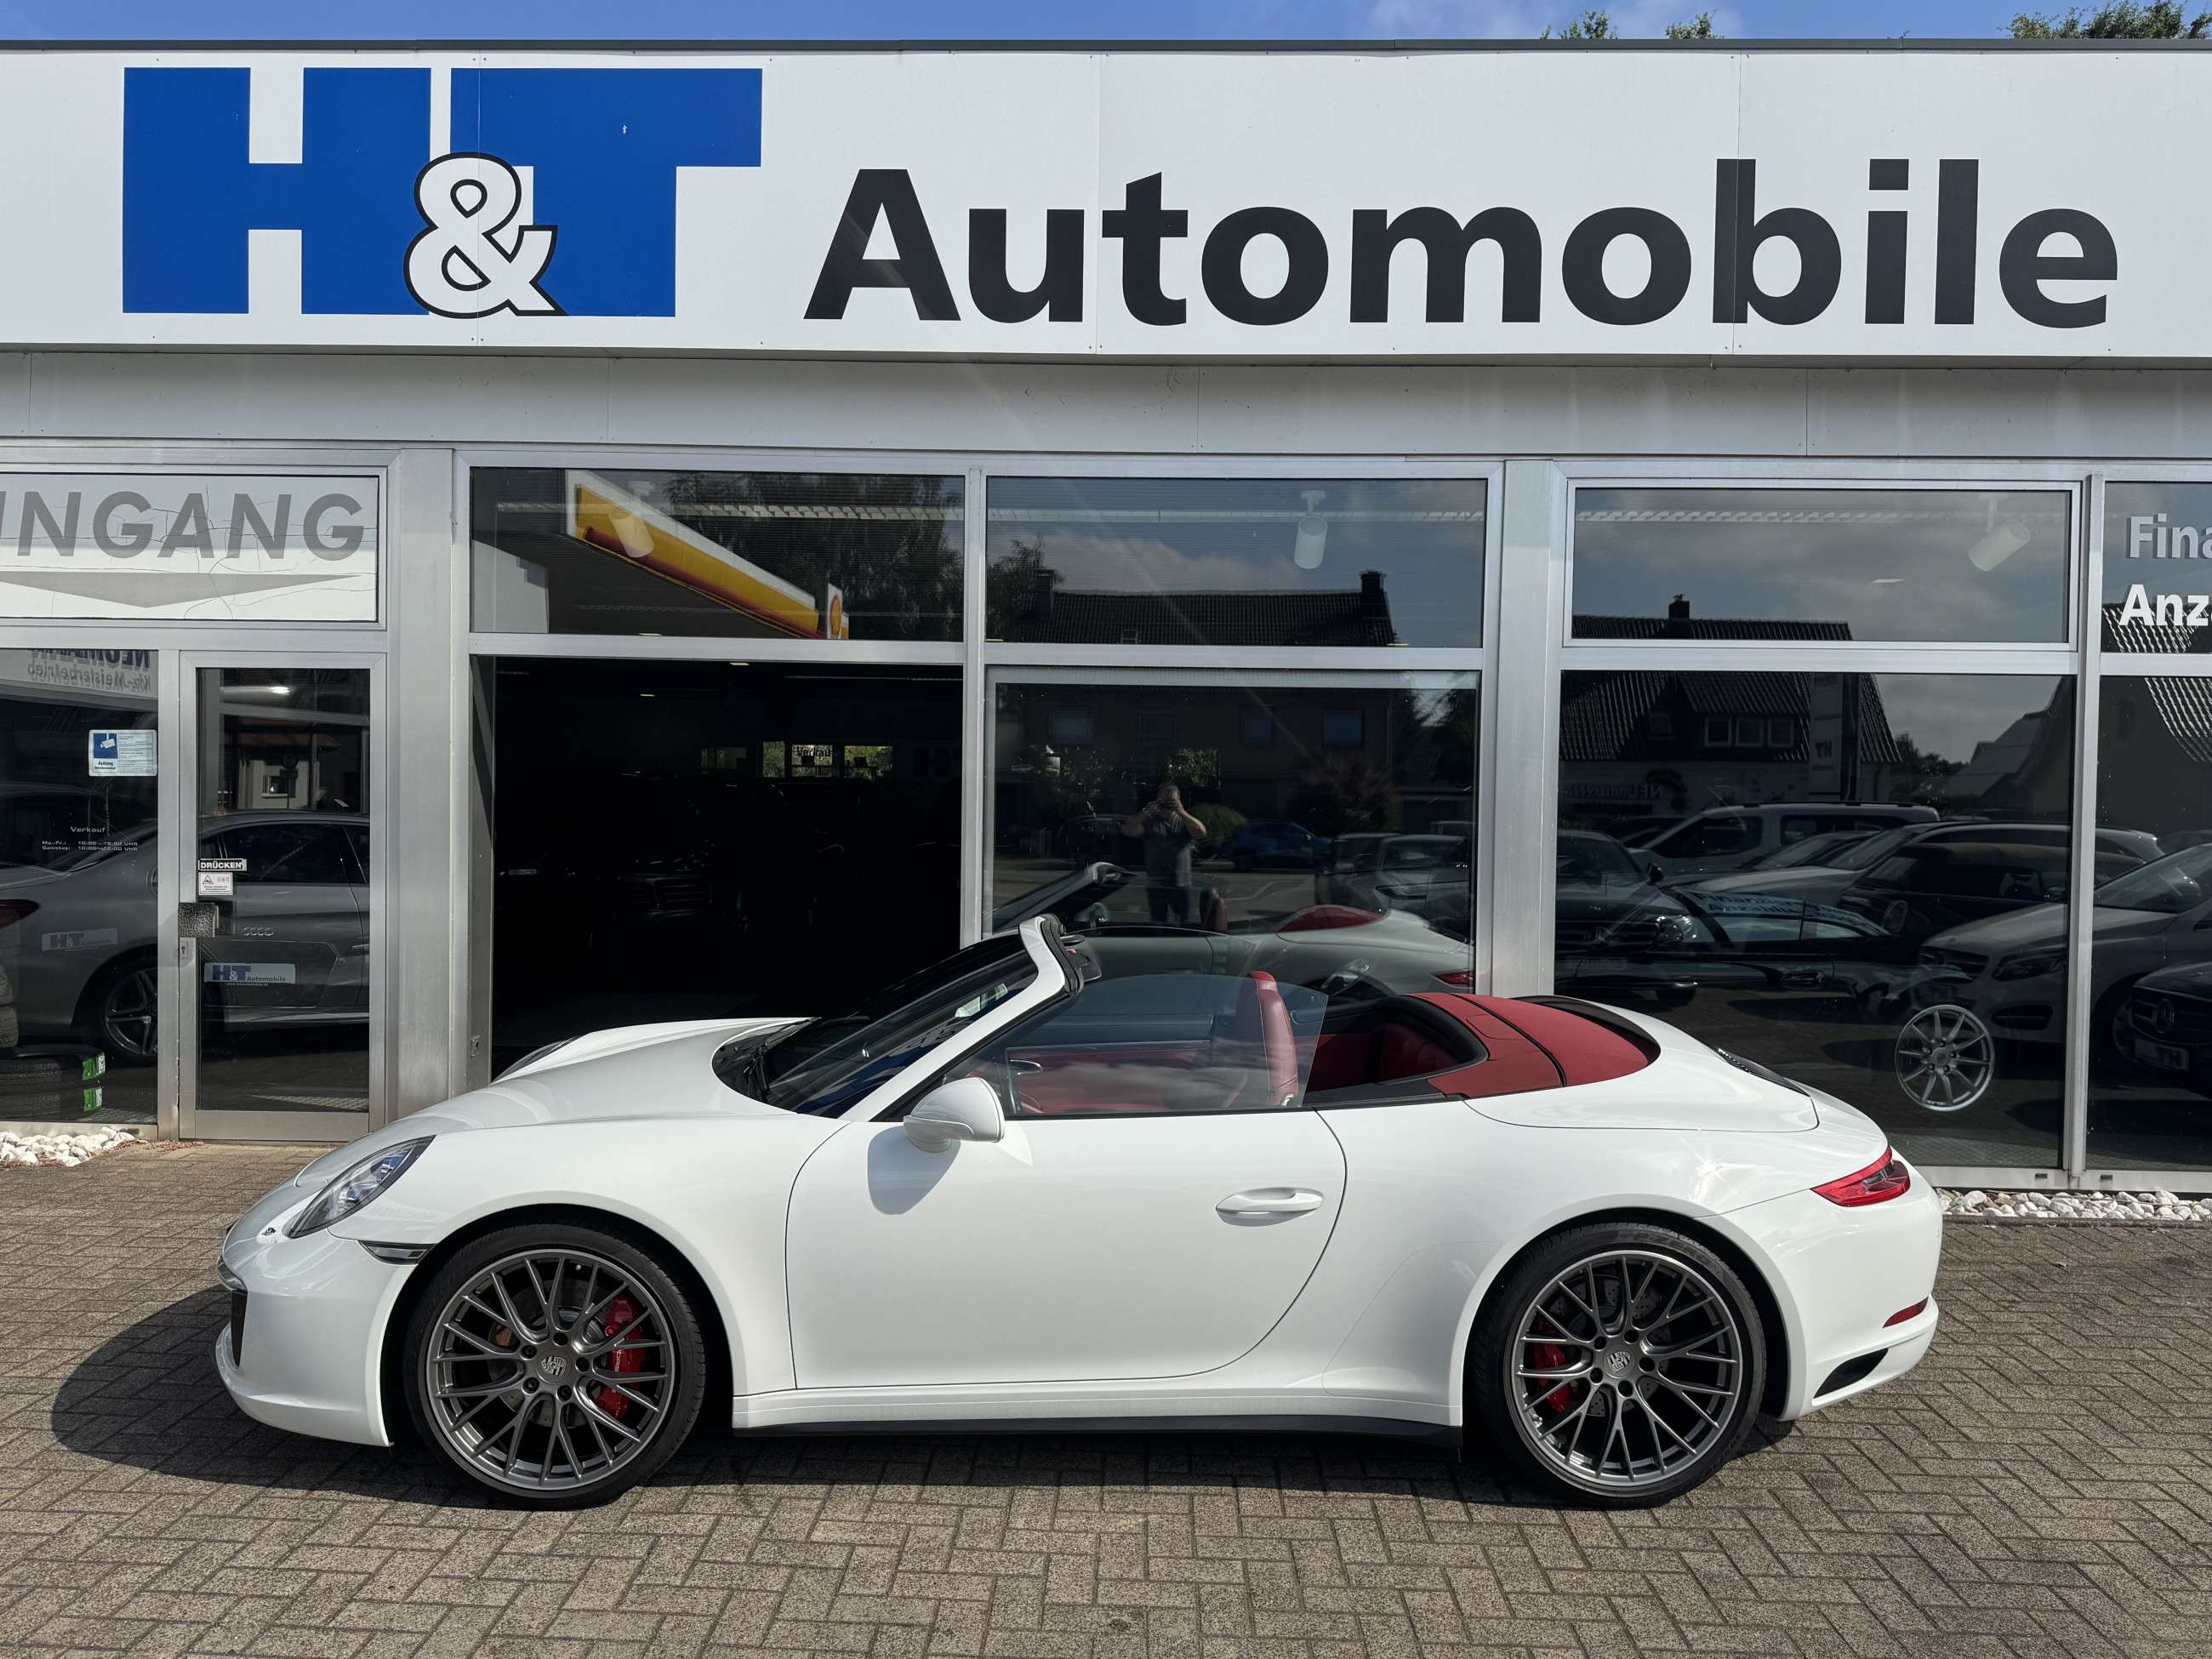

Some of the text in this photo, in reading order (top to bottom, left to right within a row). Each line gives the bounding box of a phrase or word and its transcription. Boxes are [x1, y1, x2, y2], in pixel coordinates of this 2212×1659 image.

[123, 67, 2118, 329] H&T Automobile
[2118, 584, 2212, 626] Anz
[200, 860, 242, 869] DRÜCKEN
[213, 965, 286, 982] H&T Automobile
